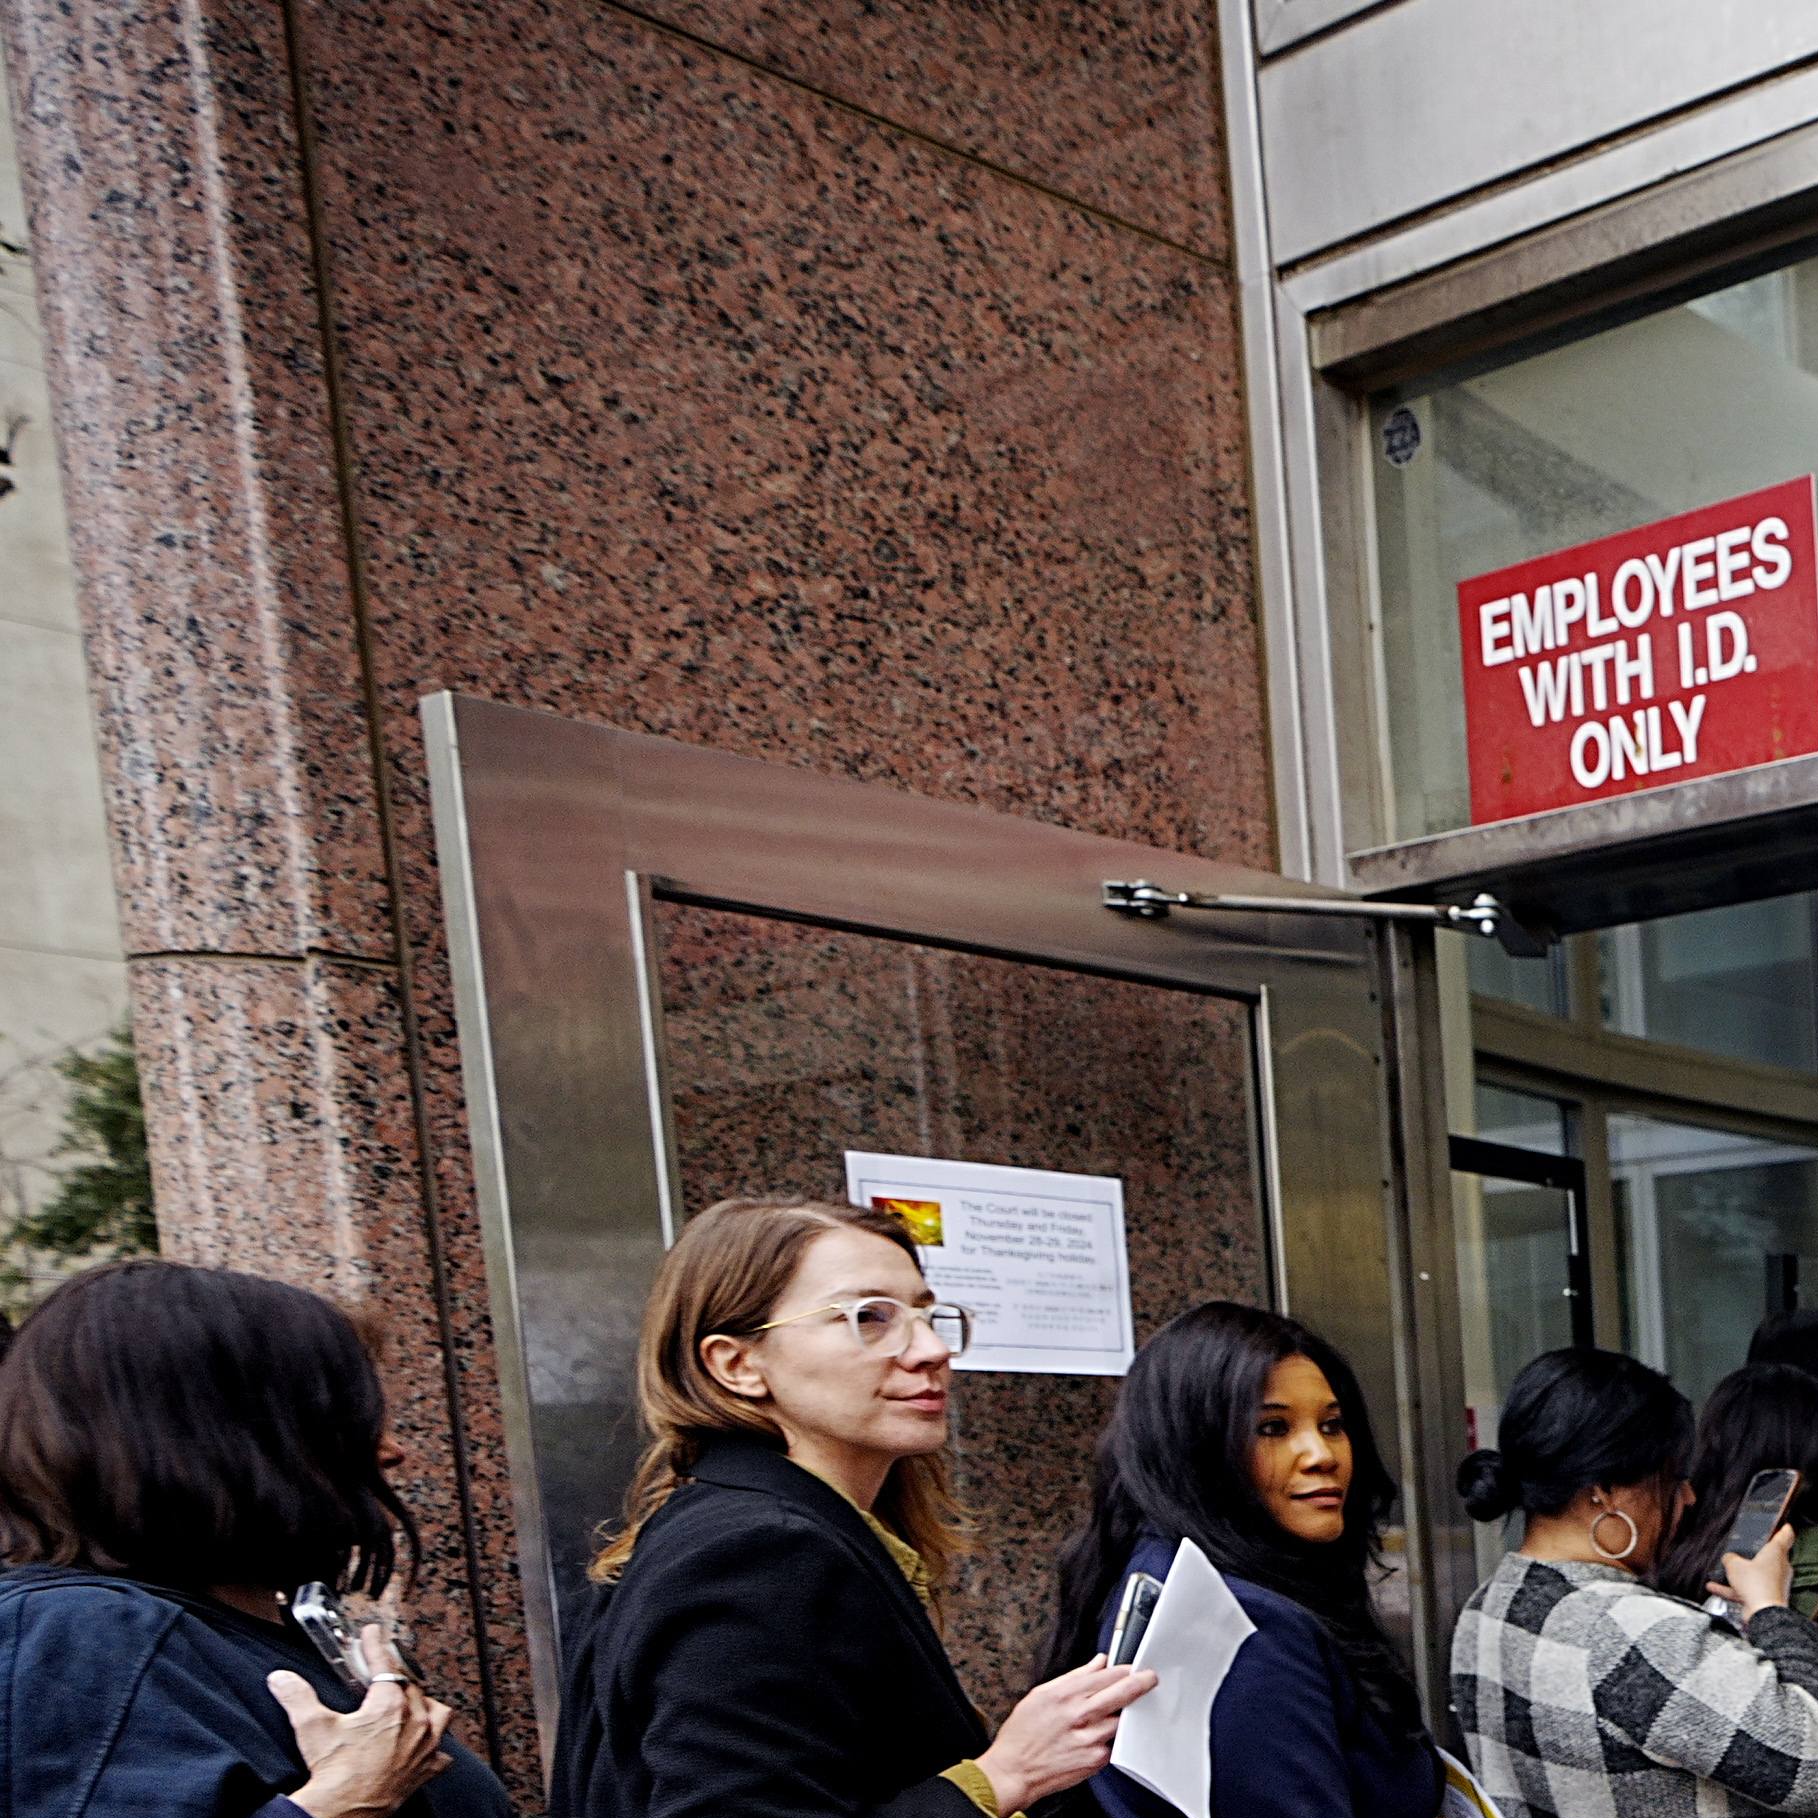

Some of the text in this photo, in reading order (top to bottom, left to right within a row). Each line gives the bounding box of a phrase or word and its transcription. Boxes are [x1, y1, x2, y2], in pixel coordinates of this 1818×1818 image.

[1479, 516, 1792, 667] EMPLOYEES
[1518, 610, 1758, 728] WITH I.D.
[1569, 693, 1707, 789] ONLY
